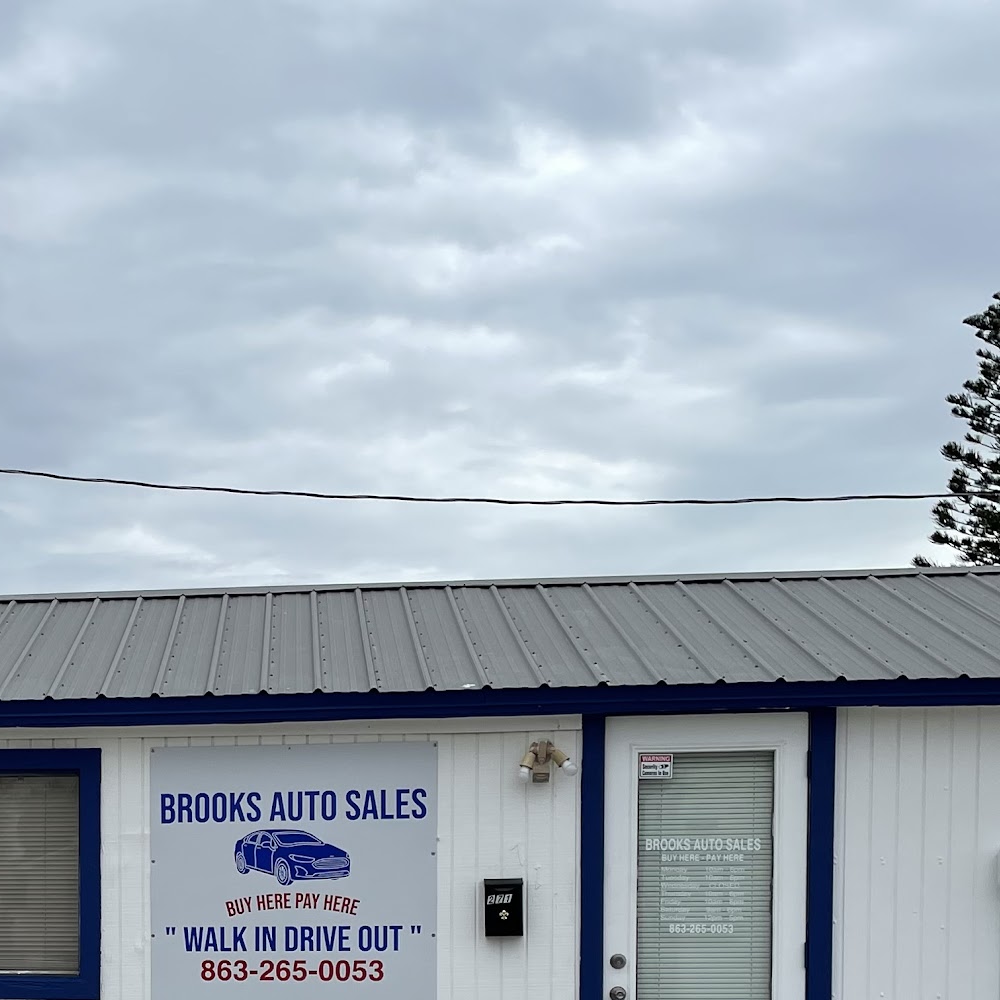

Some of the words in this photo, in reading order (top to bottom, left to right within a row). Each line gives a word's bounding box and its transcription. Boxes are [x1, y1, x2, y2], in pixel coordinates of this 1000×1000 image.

[160, 791, 261, 824] BROOKS
[269, 790, 337, 822] AUTO
[345, 788, 427, 820] SALES
[645, 838, 691, 851] BROOKS
[693, 838, 724, 851] AUTO
[726, 838, 761, 851] SALES
[661, 854, 677, 862] BUY
[679, 854, 700, 862] HERE
[706, 854, 722, 862] PAY
[723, 854, 744, 862] HERE
[225, 897, 252, 917] BUY
[256, 893, 292, 911] HERE
[295, 893, 321, 909] PAY
[323, 894, 361, 916] HERE
[183, 926, 248, 952] WALK
[254, 926, 277, 952] IN
[284, 926, 351, 952] DRIVE
[358, 925, 403, 951] OUT
[669, 923, 734, 934] 863-265-0053
[200, 959, 385, 982] 863-265-0053
